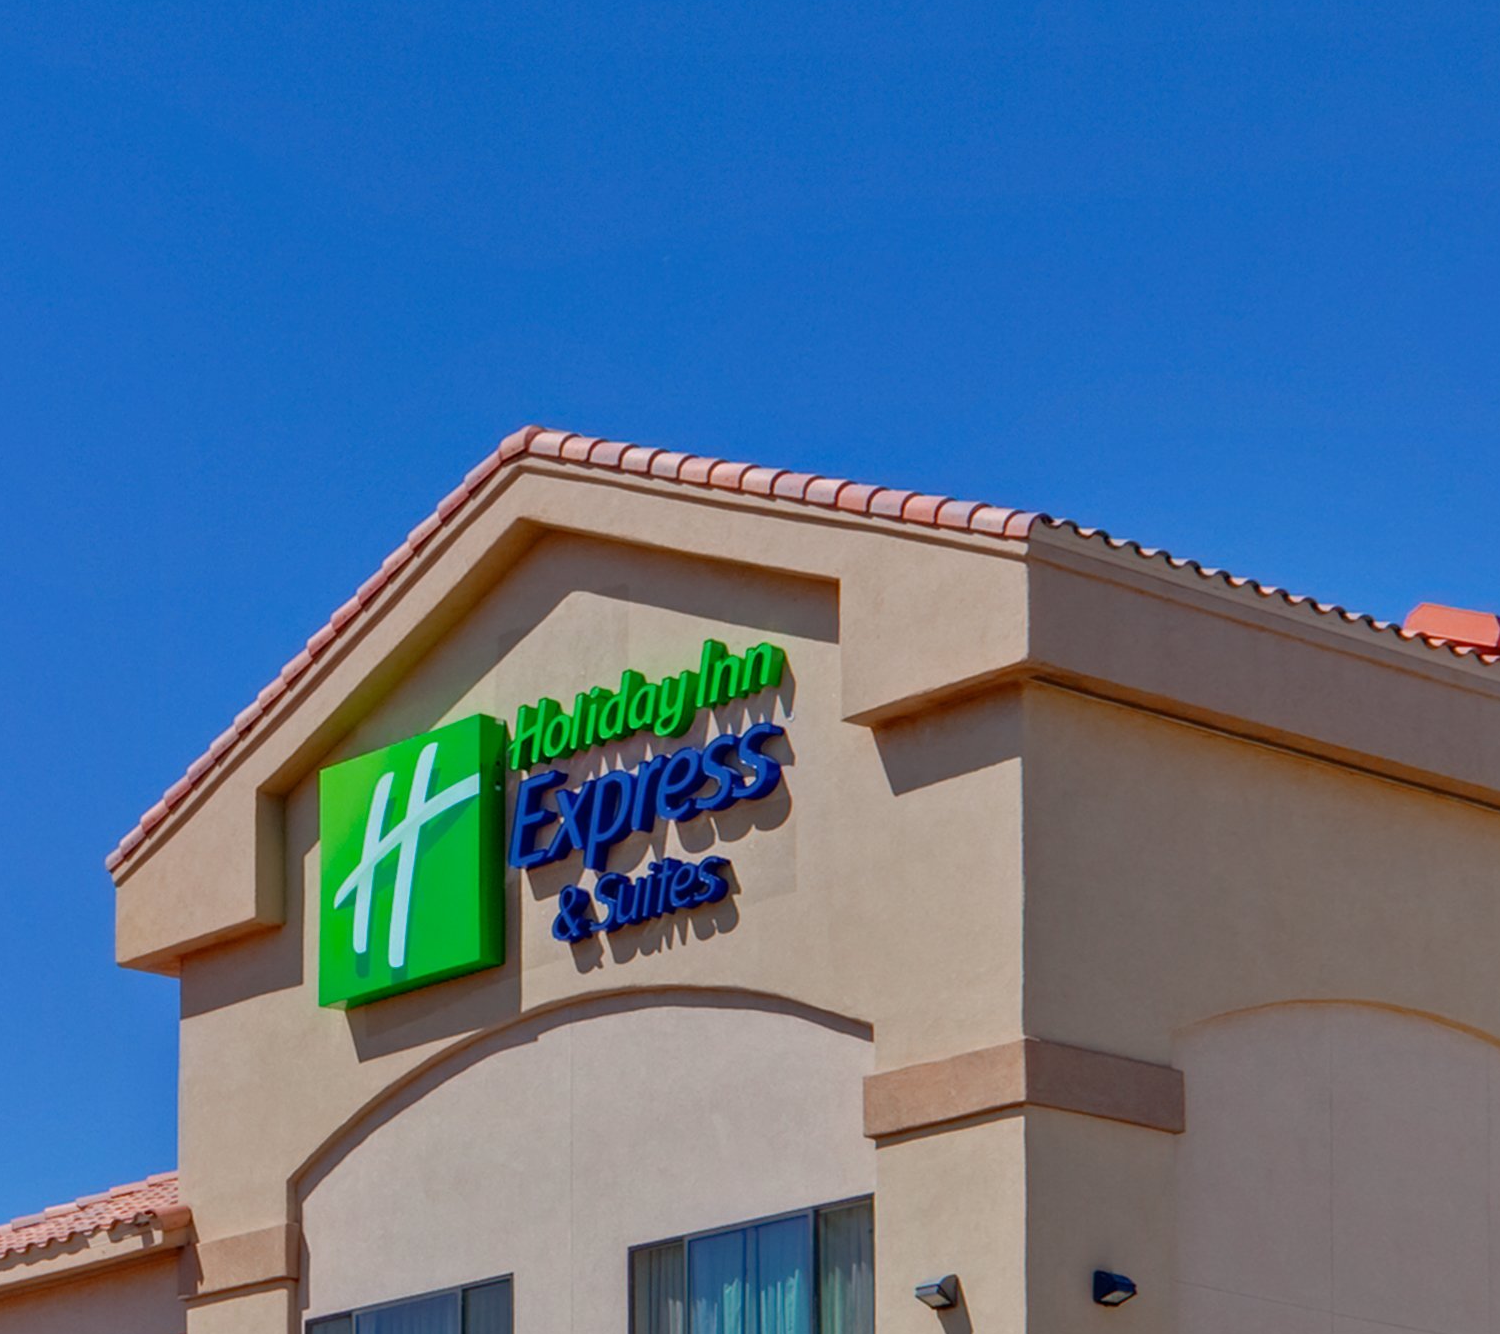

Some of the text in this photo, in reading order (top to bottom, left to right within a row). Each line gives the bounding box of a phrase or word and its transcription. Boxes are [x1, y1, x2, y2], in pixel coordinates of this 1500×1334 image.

[508, 639, 786, 770] Holiday Inn
[508, 722, 785, 870] Express
[552, 856, 732, 943] & Suites
